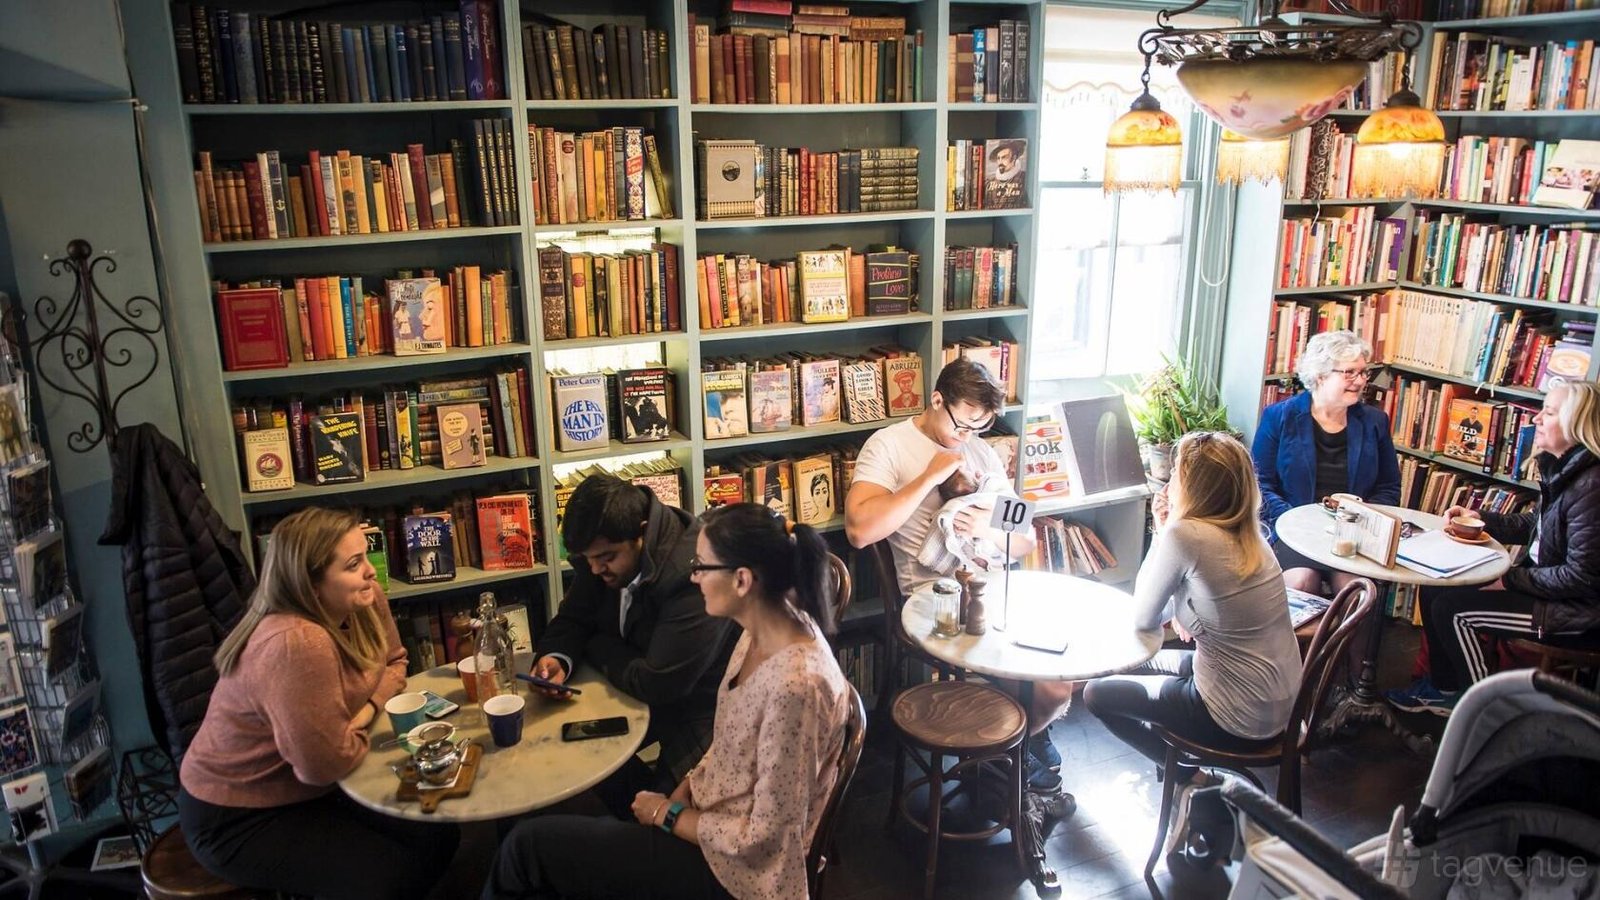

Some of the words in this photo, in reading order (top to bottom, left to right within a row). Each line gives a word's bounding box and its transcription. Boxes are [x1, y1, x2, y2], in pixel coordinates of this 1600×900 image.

[871, 267, 902, 282] Profane
[885, 282, 904, 296] Love
[890, 361, 921, 370] ABRUZZI
[559, 378, 578, 387] Peter
[580, 377, 602, 385] Carey
[564, 400, 584, 416] THE
[585, 400, 602, 412] FAT
[324, 417, 340, 425] THE
[562, 413, 591, 430] MAN
[594, 413, 605, 427] IN
[337, 428, 359, 438] KNIFE
[565, 427, 602, 442] HISTORY
[1449, 423, 1478, 436] WILD
[1025, 440, 1062, 457] ook
[1003, 500, 1027, 525] 10
[418, 530, 442, 538] DOOR
